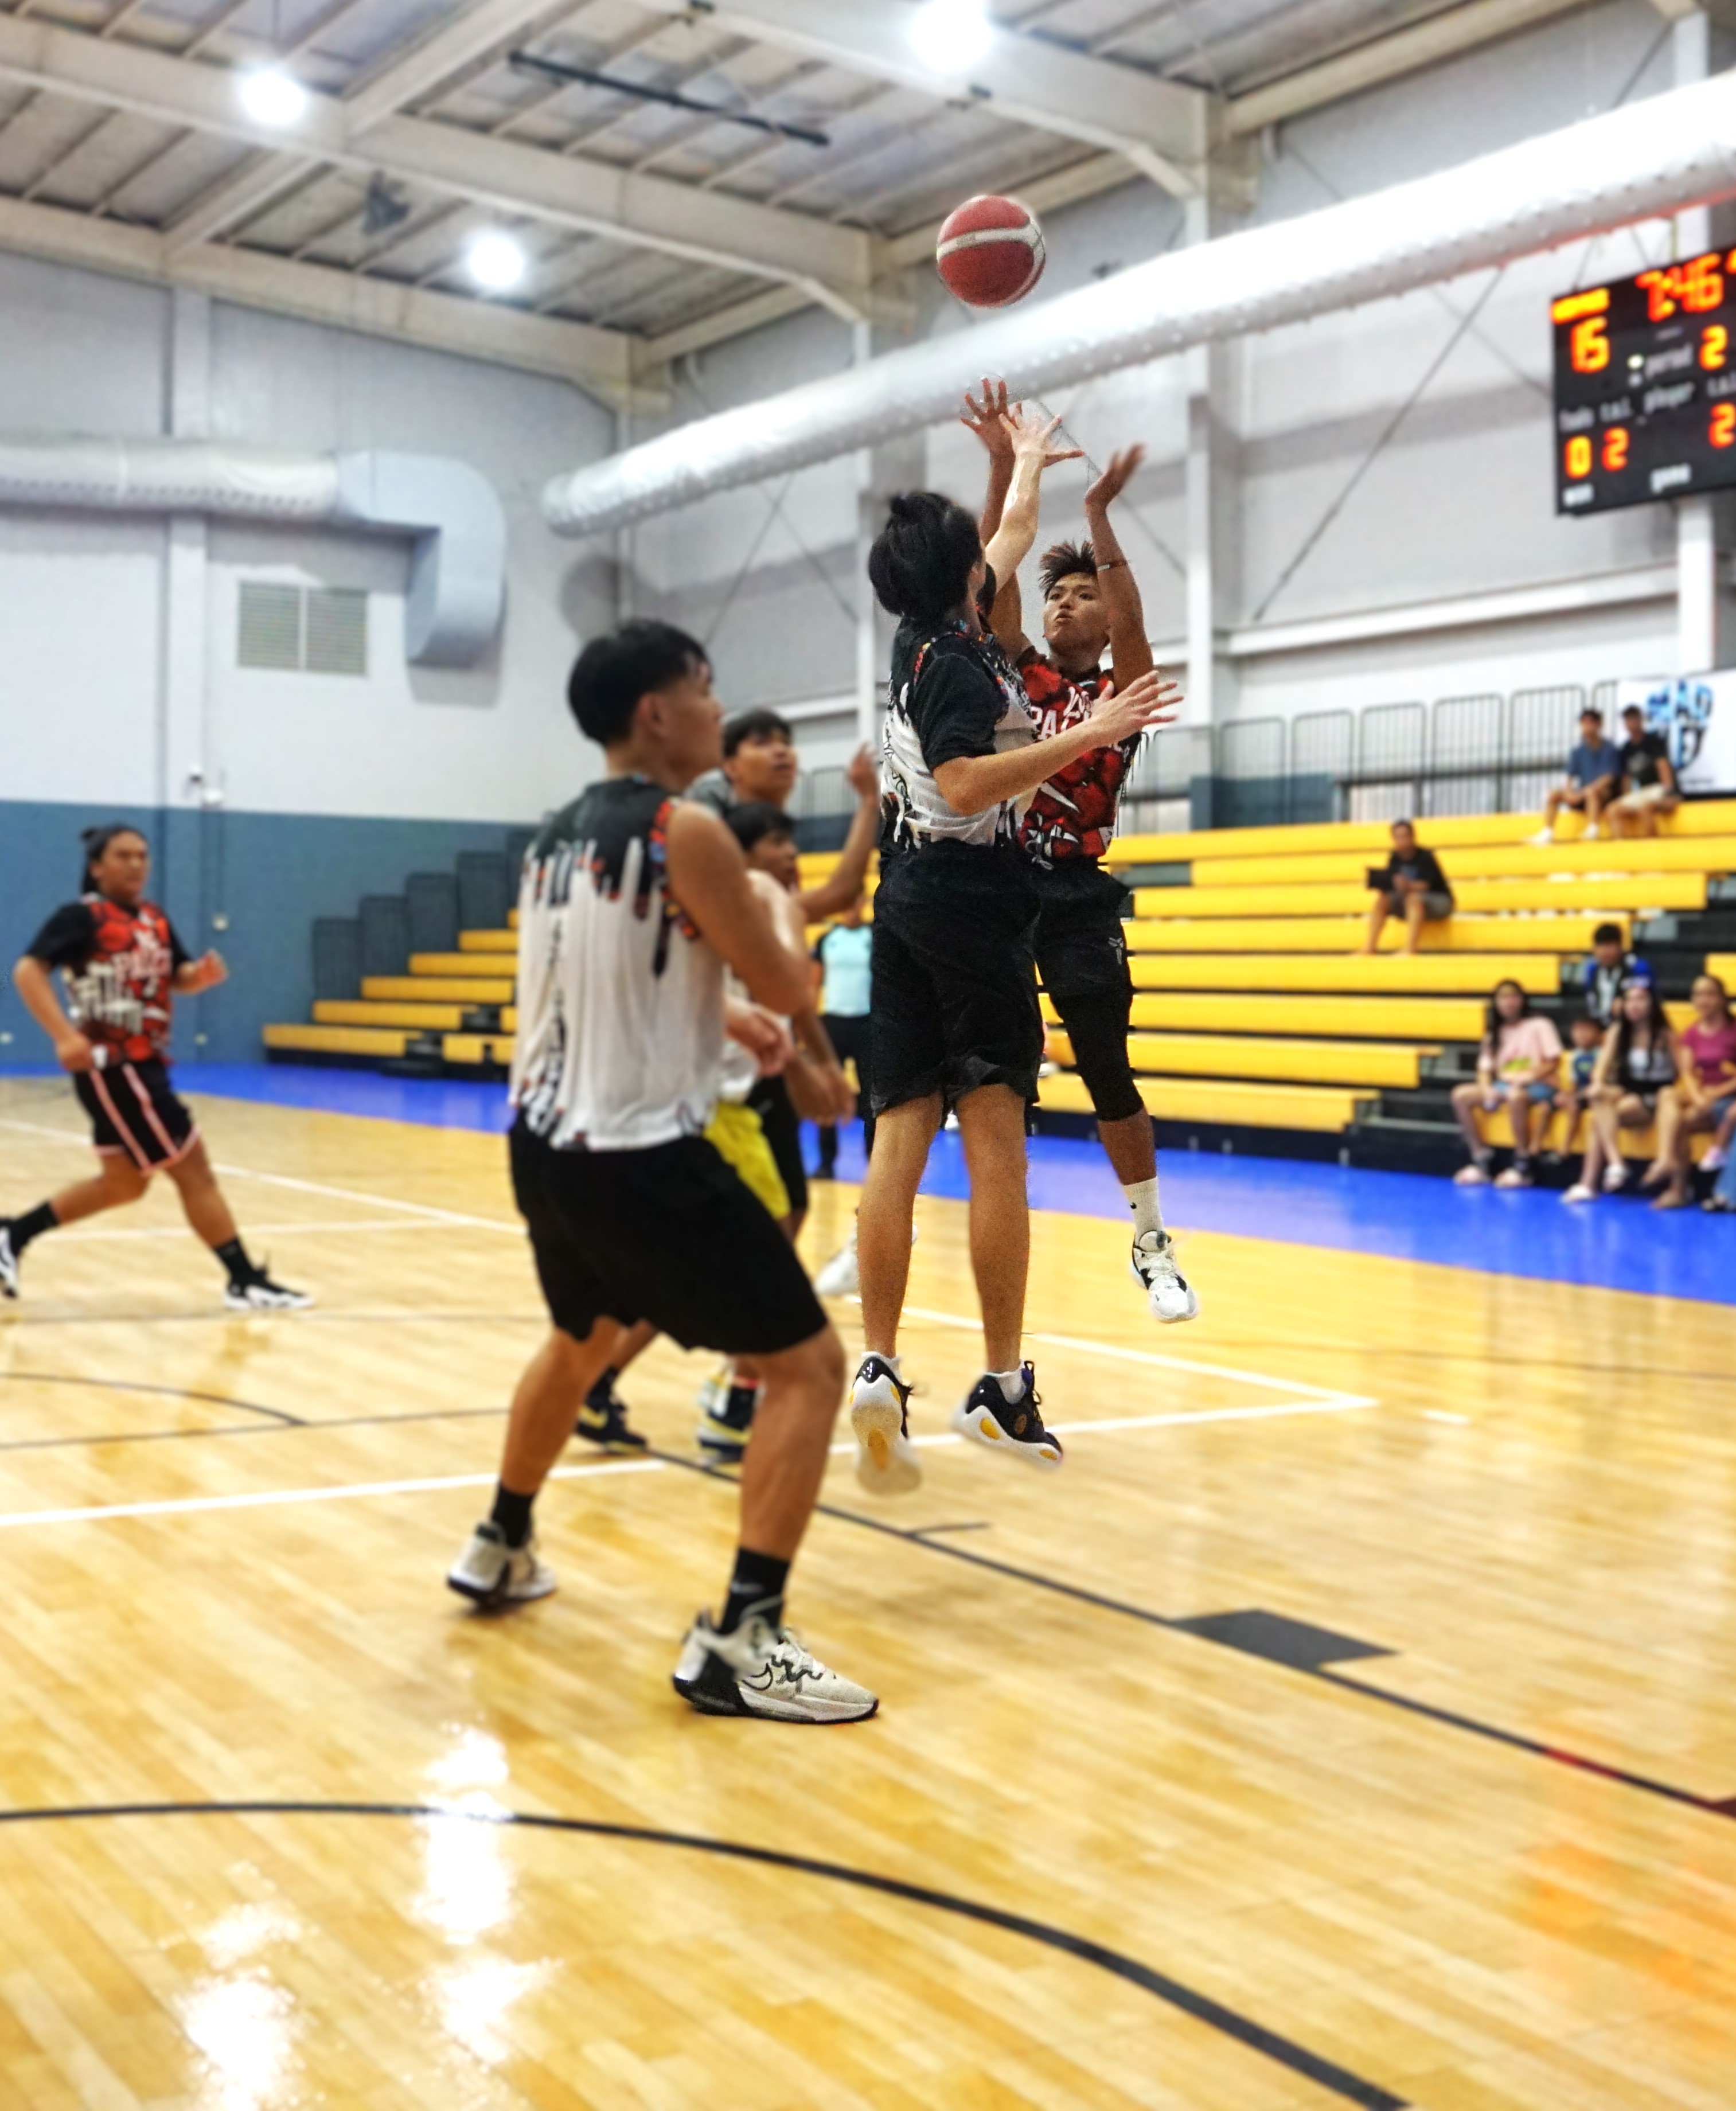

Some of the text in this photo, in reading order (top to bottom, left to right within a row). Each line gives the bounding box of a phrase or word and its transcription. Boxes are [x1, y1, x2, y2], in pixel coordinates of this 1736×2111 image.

[1699, 325, 1727, 370] 2
[1565, 435, 1592, 478] 0
[1602, 427, 1629, 471] 2
